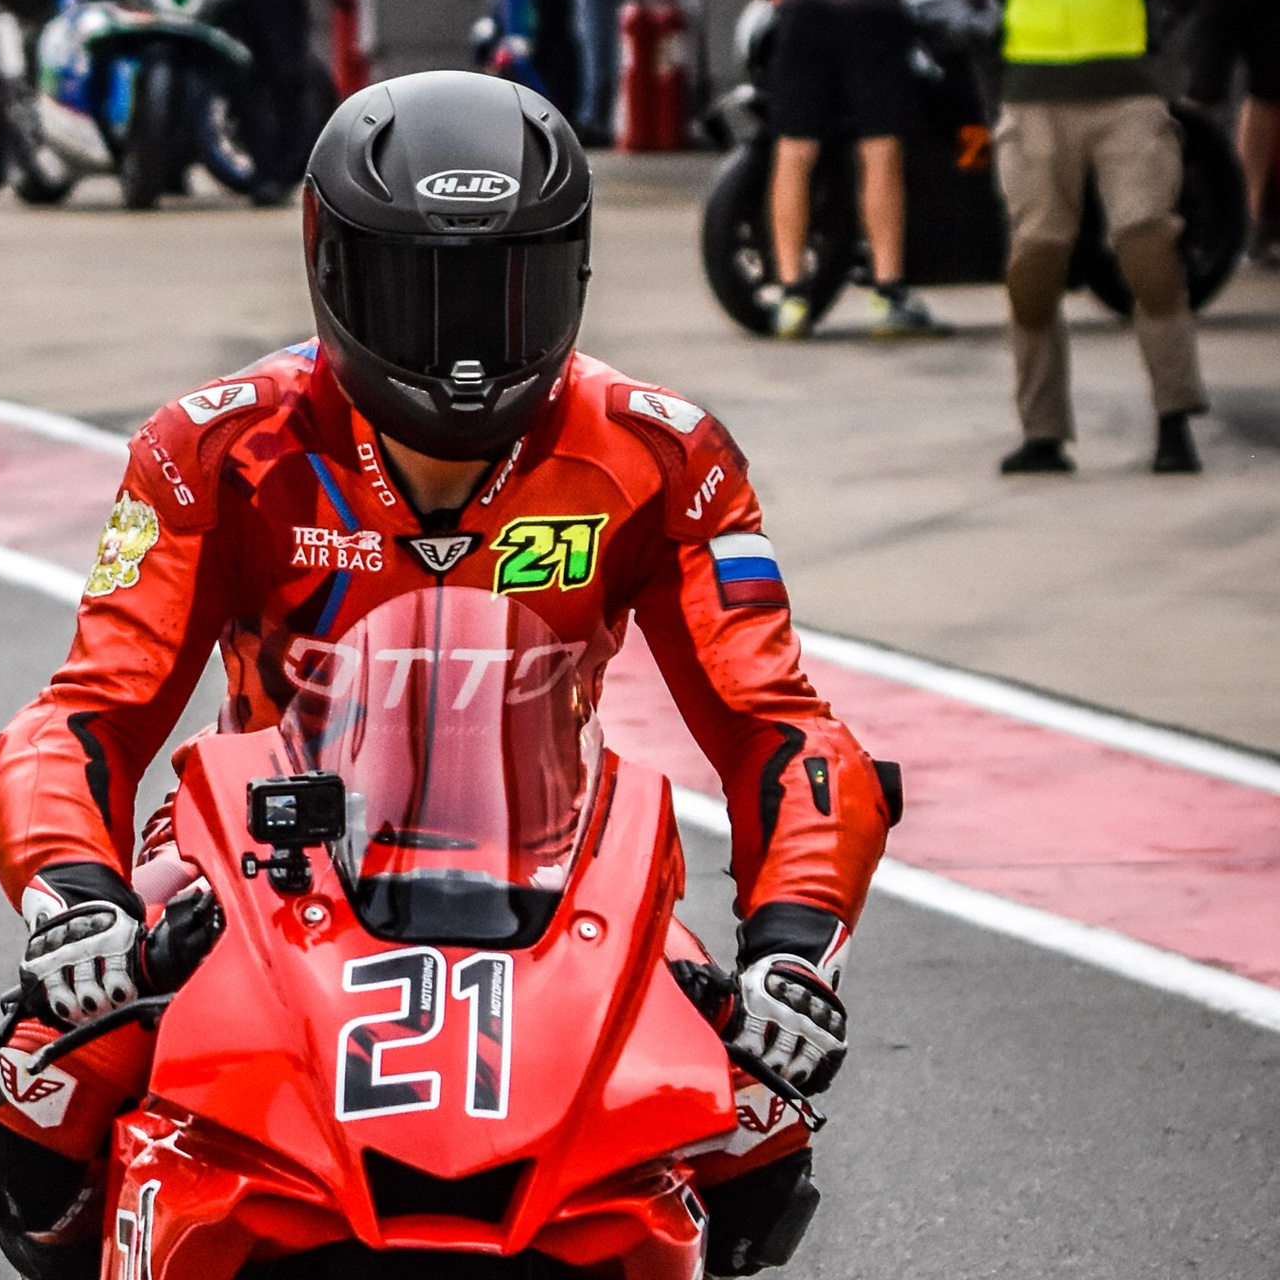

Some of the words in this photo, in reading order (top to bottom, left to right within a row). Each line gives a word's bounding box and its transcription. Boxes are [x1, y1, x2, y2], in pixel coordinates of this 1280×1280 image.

[433, 177, 504, 194] HJC
[357, 442, 397, 507] OTTO
[492, 516, 605, 595] 21
[284, 637, 587, 711] OTTO
[421, 956, 435, 1011] MOTORING
[490, 961, 504, 1017] MOTORING
[336, 946, 514, 1122] 21
